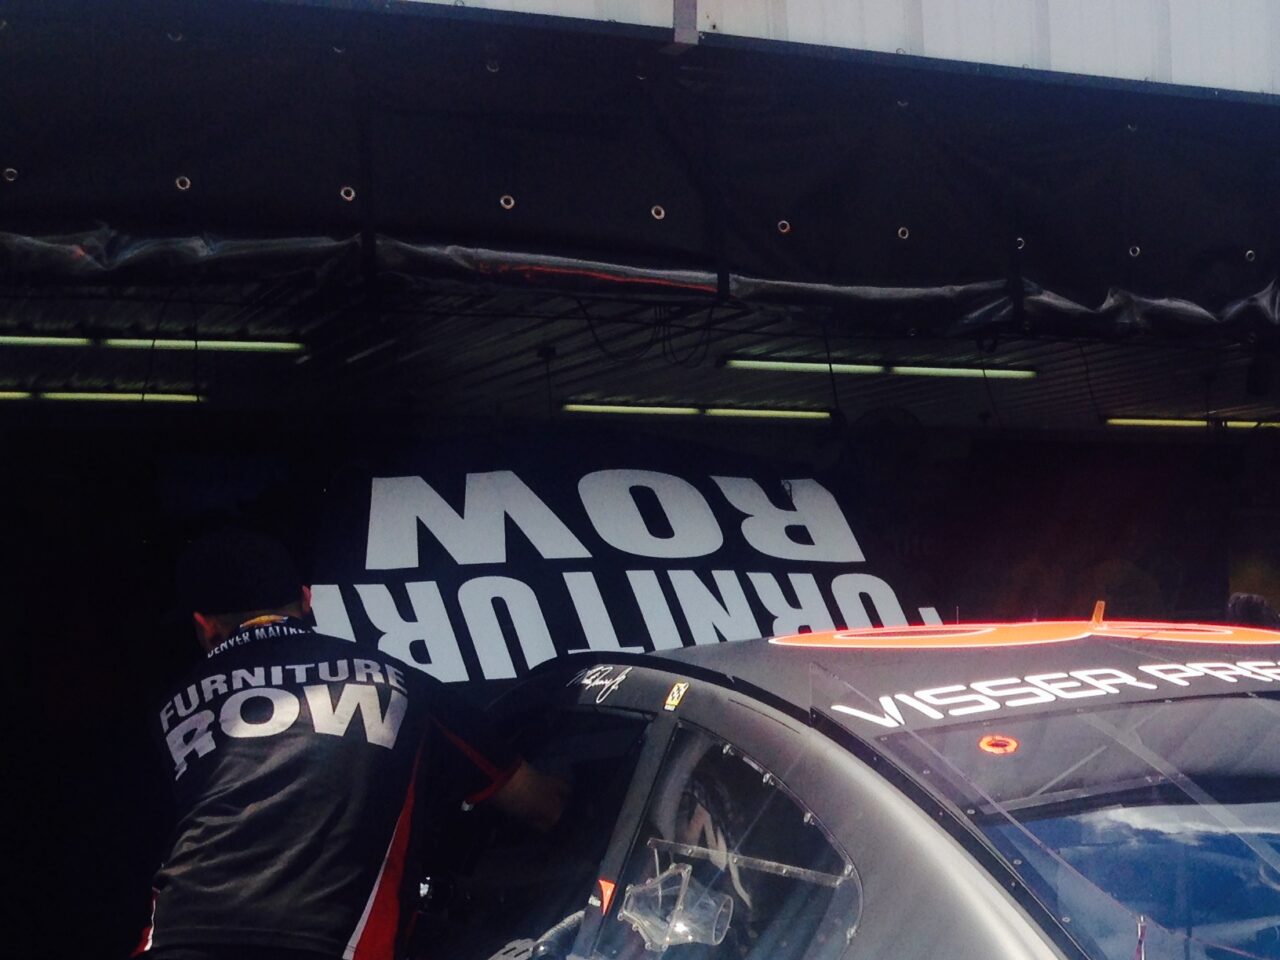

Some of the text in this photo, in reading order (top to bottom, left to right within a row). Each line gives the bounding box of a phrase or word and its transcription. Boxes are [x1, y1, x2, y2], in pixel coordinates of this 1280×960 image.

[365, 469, 867, 571] ROW
[310, 568, 945, 684] URNITUR
[159, 658, 408, 733] FURNITURE
[166, 682, 408, 781] ROW
[831, 666, 1157, 728] VISSER
